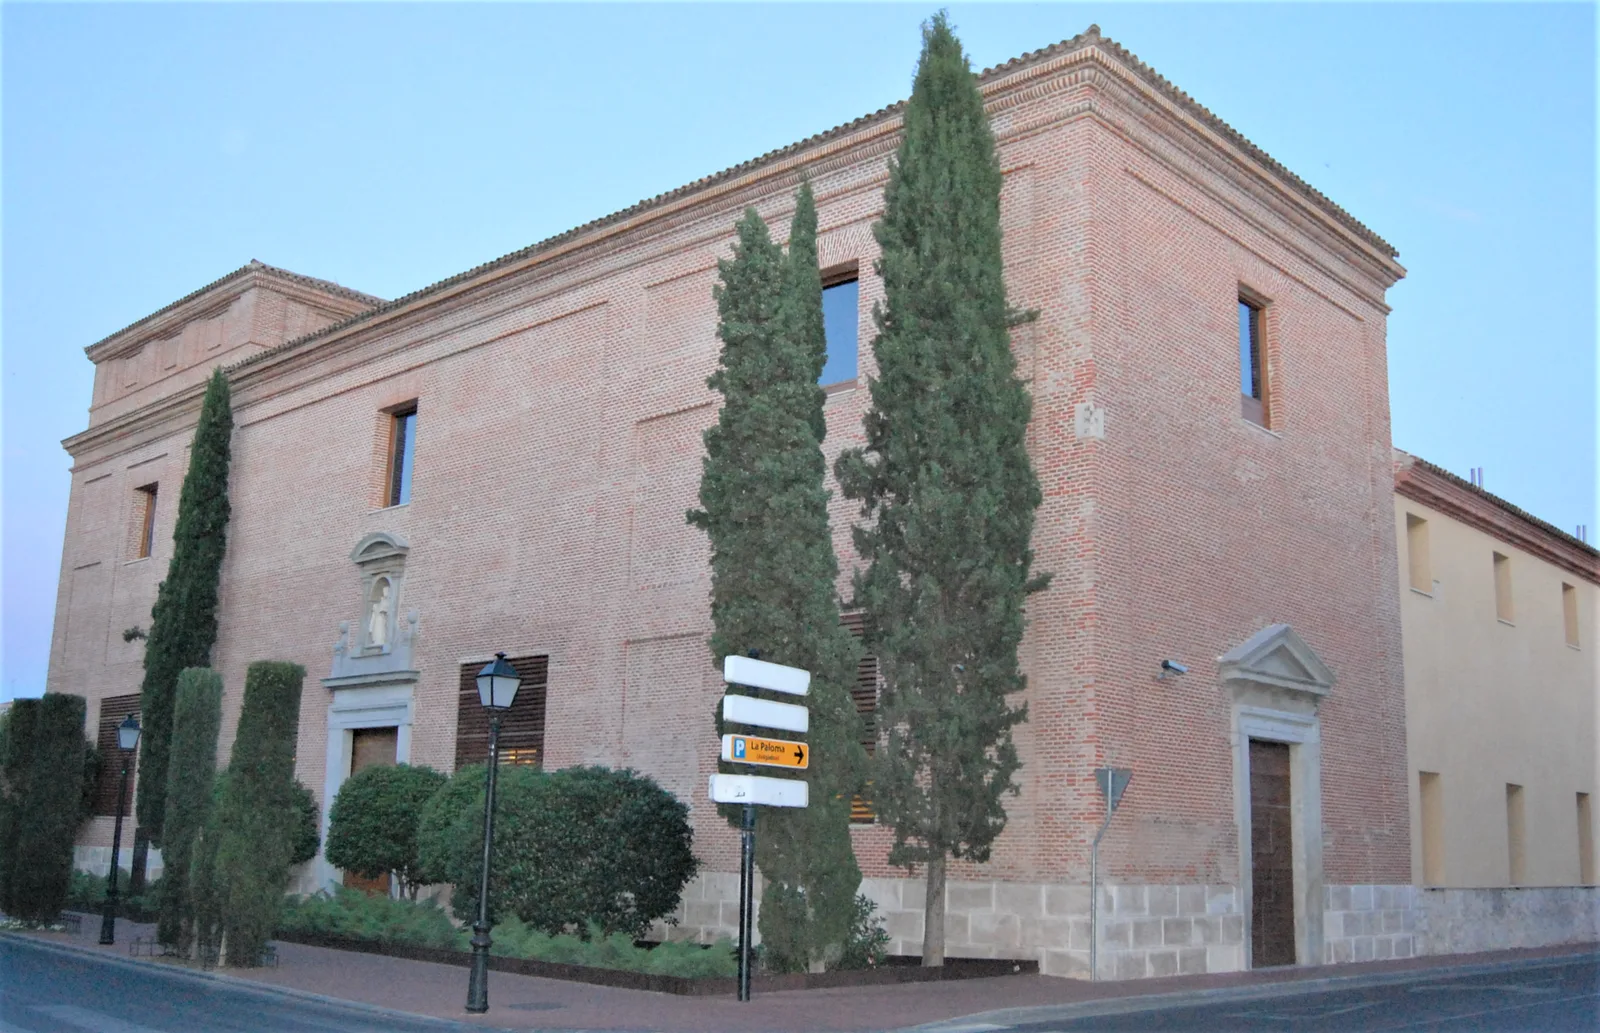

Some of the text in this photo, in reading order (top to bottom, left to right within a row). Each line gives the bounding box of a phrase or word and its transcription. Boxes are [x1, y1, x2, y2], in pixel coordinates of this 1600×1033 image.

[735, 739, 745, 757] P
[751, 741, 785, 753] La Paloma
